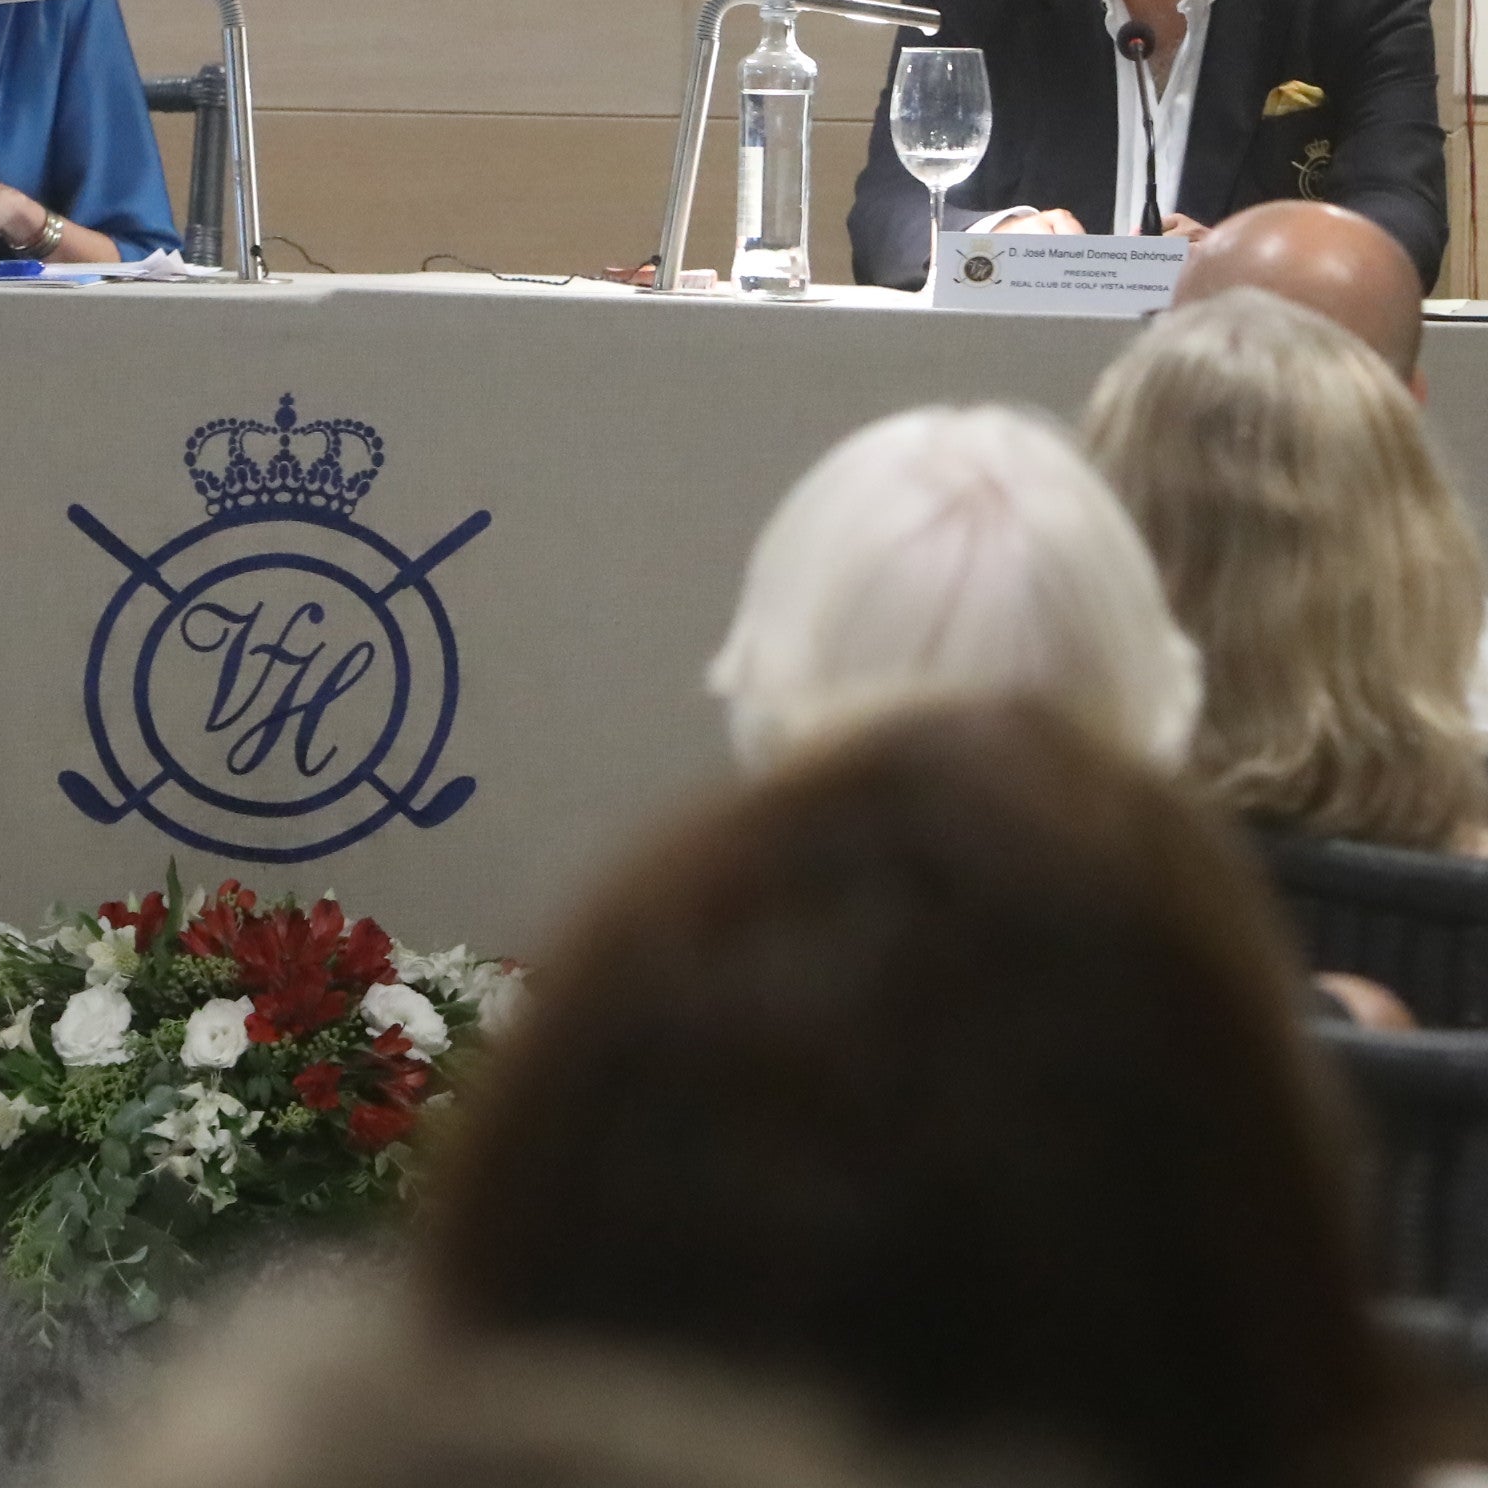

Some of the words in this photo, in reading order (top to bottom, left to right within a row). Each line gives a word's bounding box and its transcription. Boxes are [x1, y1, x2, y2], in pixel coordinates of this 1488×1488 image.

[1023, 248, 1045, 258] José
[1049, 249, 1084, 259] Manuel
[1087, 250, 1127, 261] Domecq
[1131, 250, 1183, 262] Bohórquez
[1064, 270, 1117, 278] PRESIDENTE
